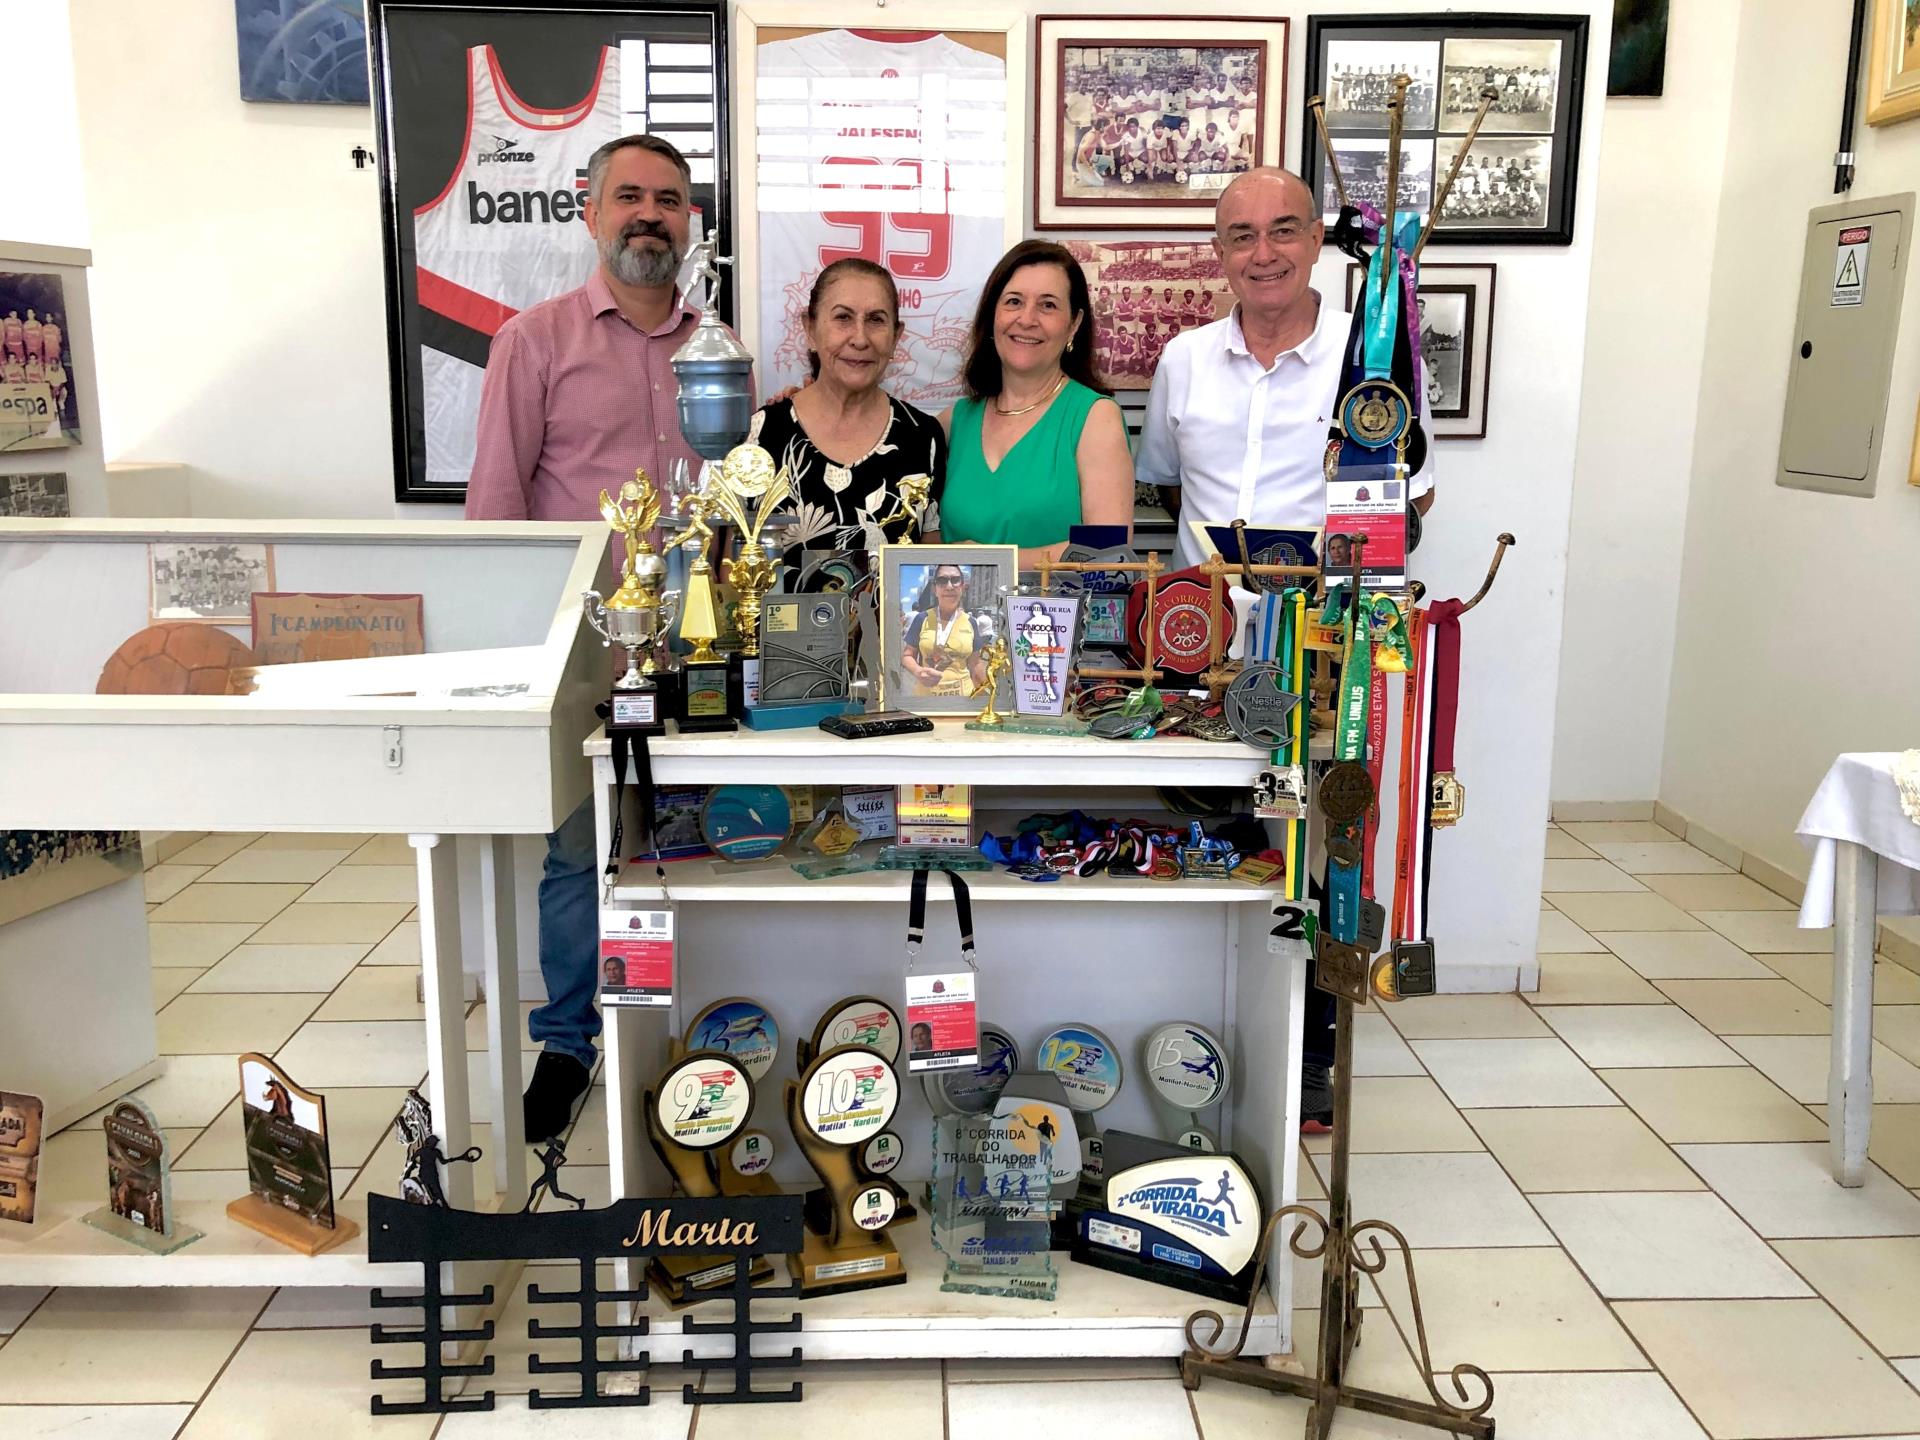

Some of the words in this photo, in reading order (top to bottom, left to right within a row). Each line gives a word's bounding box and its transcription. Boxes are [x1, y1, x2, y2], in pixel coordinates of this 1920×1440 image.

[1842, 230, 1868, 241] PERIGO
[768, 606, 781, 617] 1º
[283, 615, 406, 633] CAMPEONATO
[1028, 692, 1052, 703] RAX
[1372, 681, 1382, 711] ETAPA
[1347, 729, 1359, 744] FM
[1353, 686, 1364, 721] UNILUS
[716, 826, 729, 837] 1º
[1045, 1039, 1082, 1073] 12
[818, 1068, 857, 1116] 10
[1079, 1083, 1106, 1095] Nardini
[674, 1127, 701, 1138] Matilat
[706, 1123, 733, 1134] Nardini
[818, 1121, 846, 1133] Matilat
[853, 1116, 882, 1128] Nardini
[969, 1129, 1026, 1141] CORRIDA
[981, 1141, 1000, 1152] DO
[943, 1152, 1037, 1165] TRABALHADOR
[1129, 1186, 1198, 1204] CORRIDA
[1139, 1202, 1151, 1211] da
[1151, 1200, 1227, 1229] VIRADA
[622, 1208, 759, 1247] Maria
[960, 1247, 1000, 1256] PREFEITURA
[982, 1256, 1006, 1265] TANABI
[1010, 1257, 1019, 1266] SP
[1019, 1279, 1047, 1289] LUGAR
